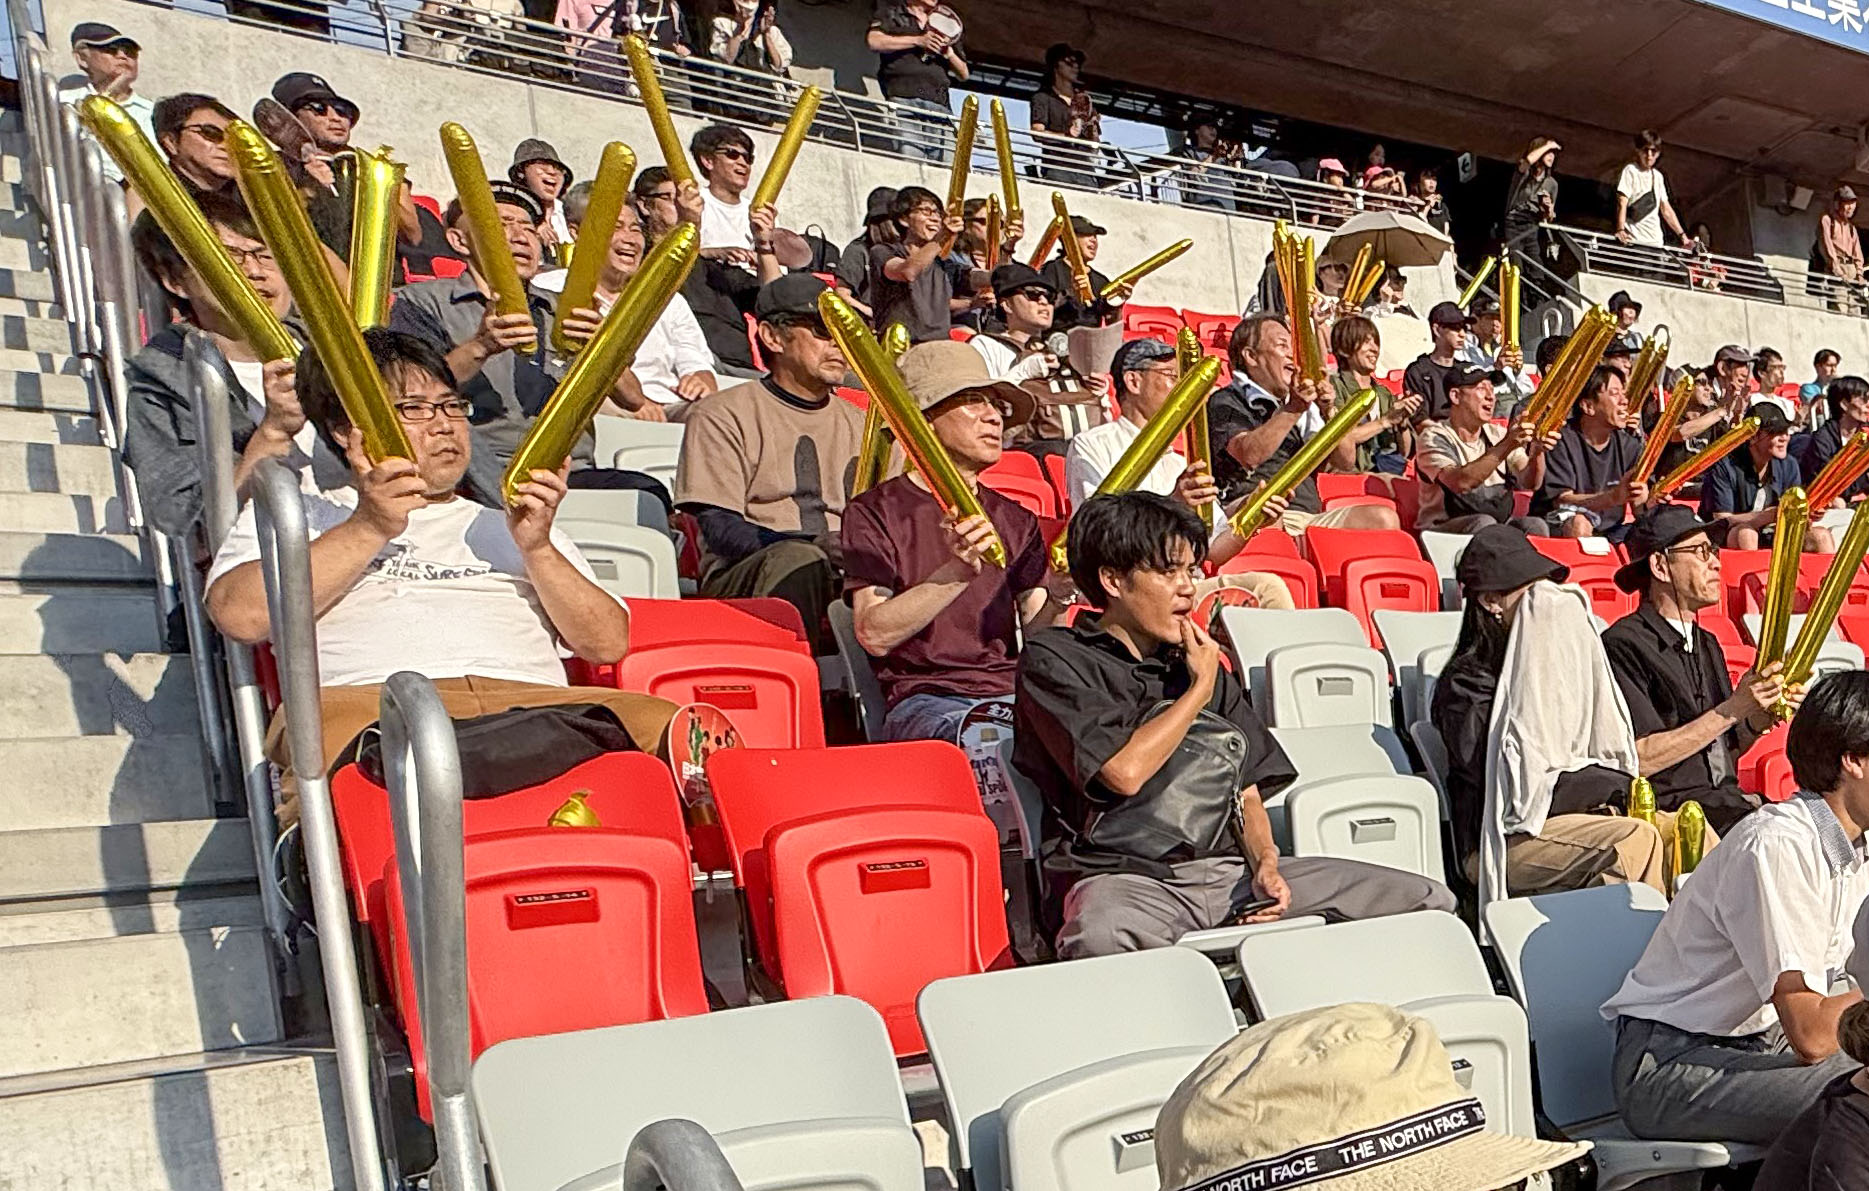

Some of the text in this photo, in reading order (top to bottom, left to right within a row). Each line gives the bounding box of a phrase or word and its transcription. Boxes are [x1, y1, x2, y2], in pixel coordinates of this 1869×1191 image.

[1270, 1155, 1319, 1183] FACE
[1338, 1139, 1377, 1164] THE
[1378, 1121, 1436, 1153] NORTH
[1433, 1110, 1469, 1135] FACE
